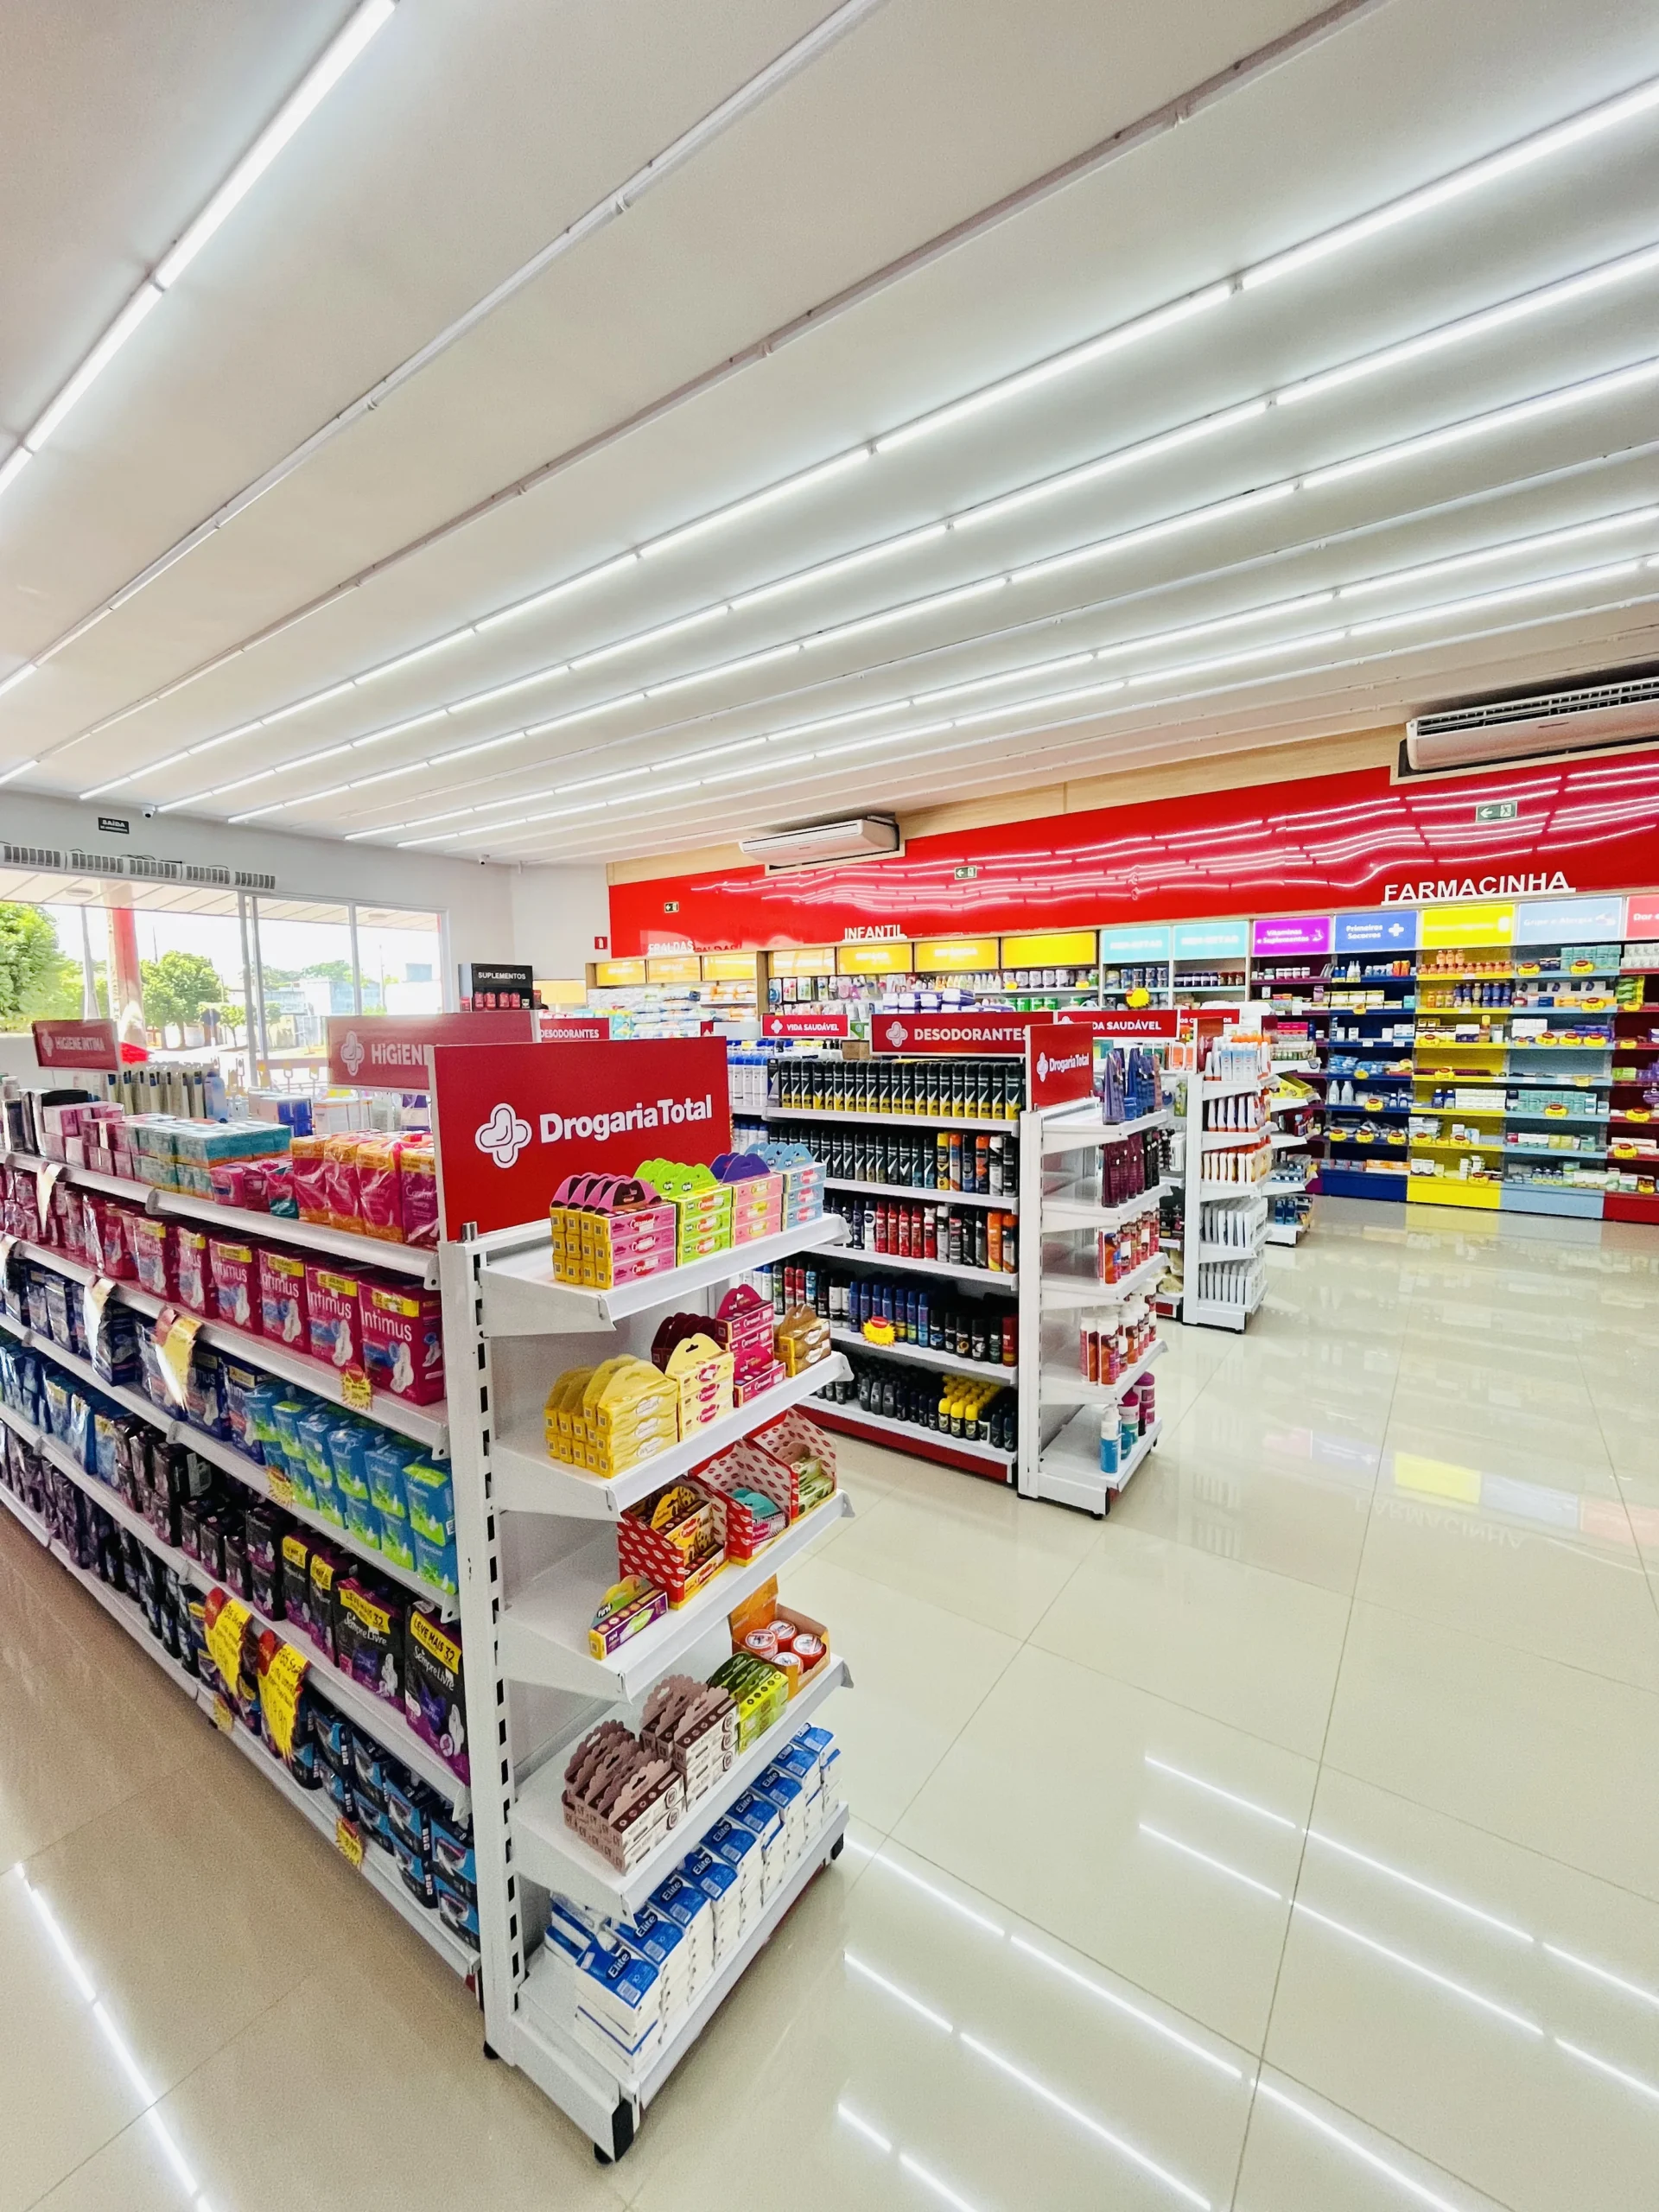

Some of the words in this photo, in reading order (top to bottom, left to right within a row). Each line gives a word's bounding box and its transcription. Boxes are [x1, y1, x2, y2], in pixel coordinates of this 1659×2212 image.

[1384, 871, 1569, 901] FARMACINHA
[844, 924, 902, 940] INFANTIL
[1267, 928, 1303, 937] Vitaminas
[1345, 924, 1383, 932] Primeiros
[648, 940, 694, 954] FRALDAS
[1263, 936, 1309, 944] Suplementos
[478, 971, 526, 980] SUPLEMENTOS
[786, 1023, 803, 1032] VIDA
[804, 1022, 840, 1032] SAUDÁVEL
[1107, 1019, 1162, 1031] SAUDÁVEL
[540, 1028, 600, 1039] DESODORANTES
[361, 1310, 413, 1342] Intimus
[373, 1613, 383, 1626] 32
[414, 1617, 429, 1637] LEVE
[428, 1632, 443, 1652] MAIS
[444, 1645, 454, 1663] 32
[762, 1771, 779, 1788] Elite
[735, 1795, 753, 1813] Elite
[713, 1823, 731, 1842] Elite
[692, 1856, 712, 1875] Elite
[661, 1881, 682, 1901] Elite
[636, 1914, 657, 1938] Elite
[607, 1953, 630, 1978] Elite
